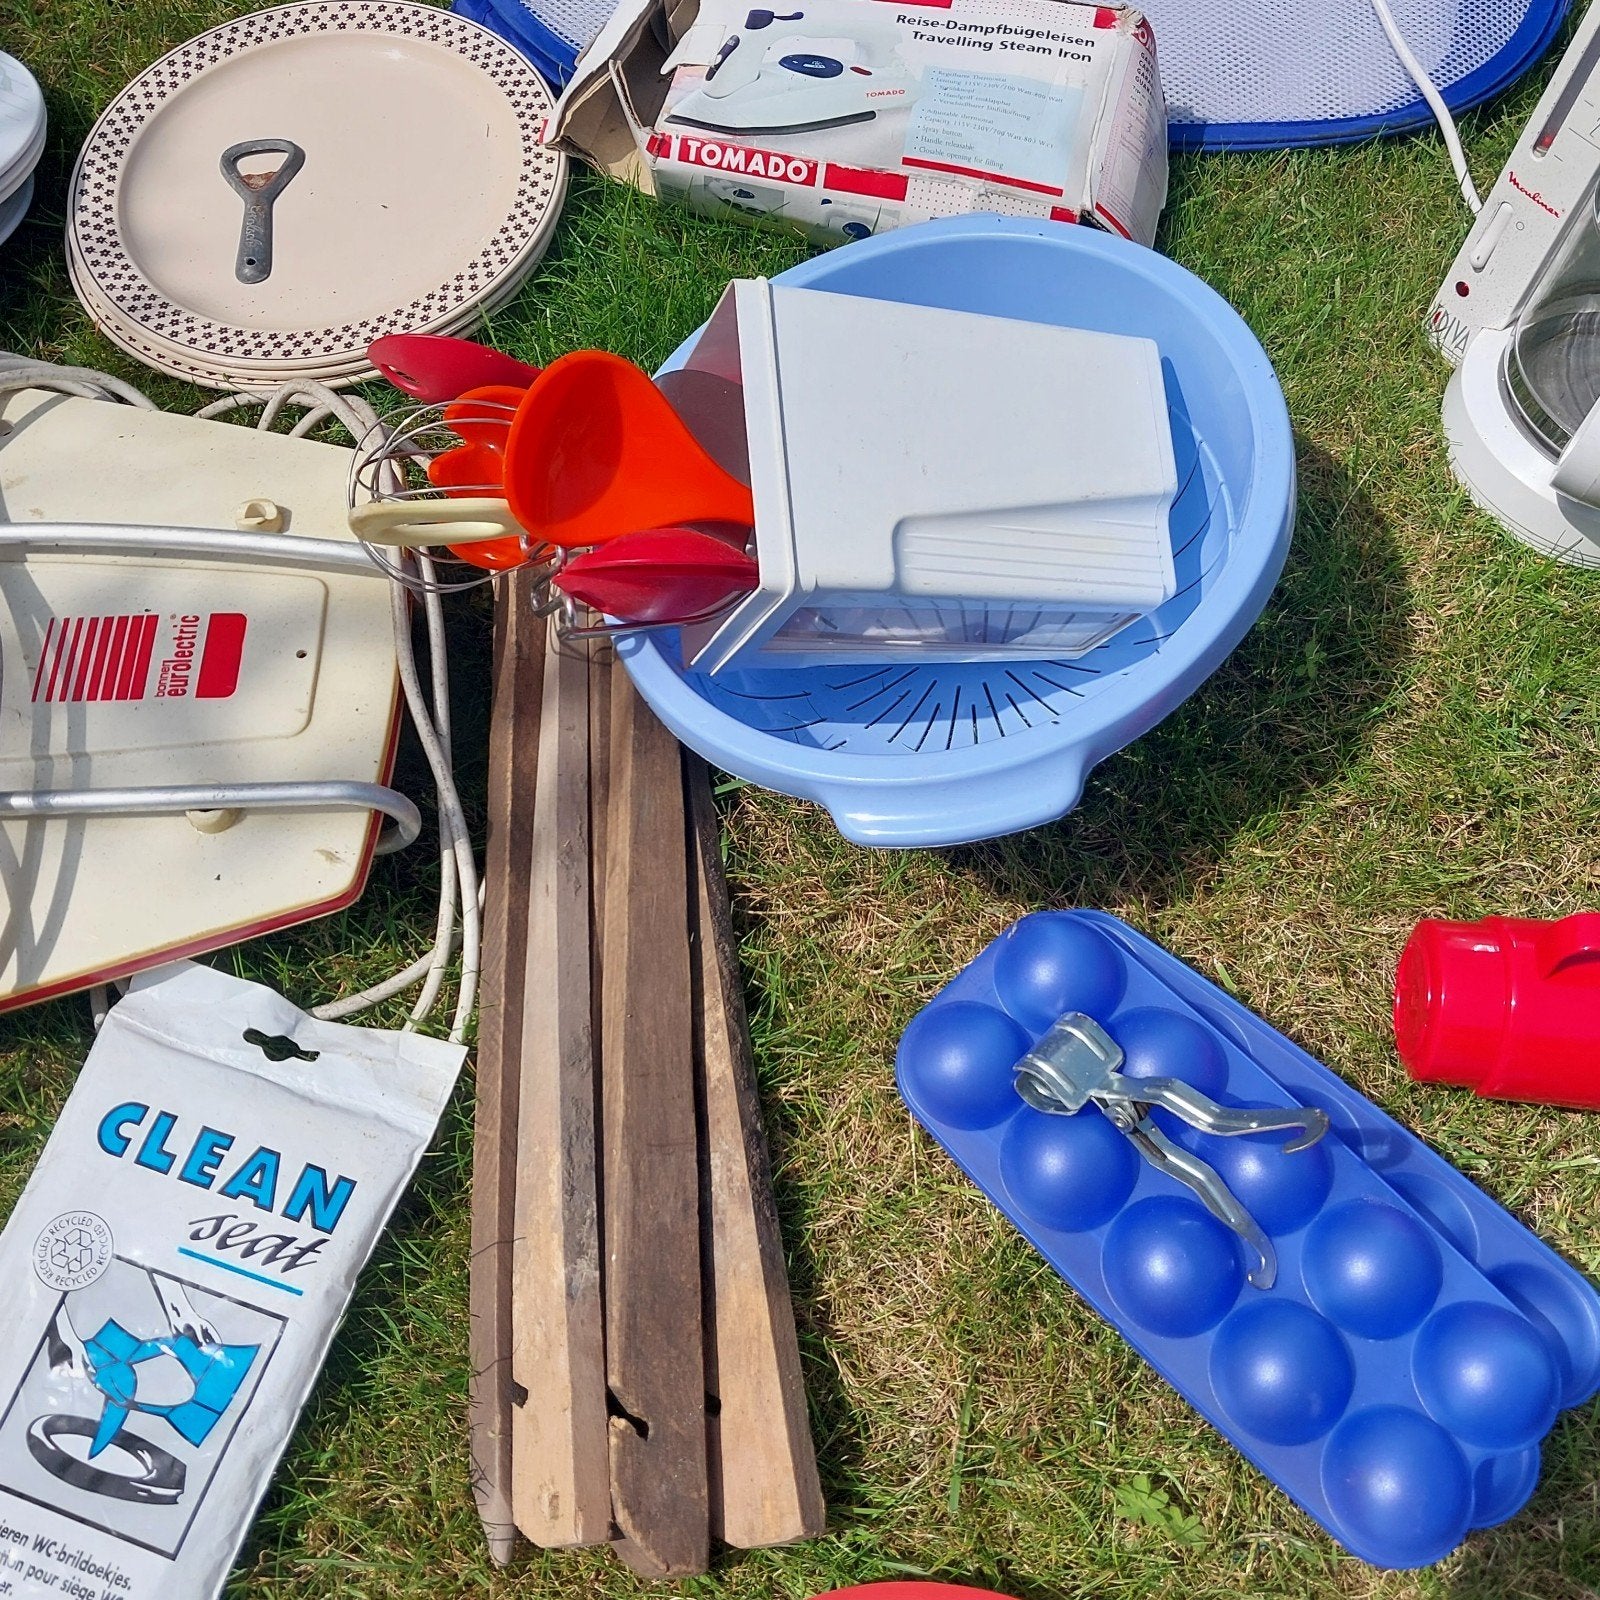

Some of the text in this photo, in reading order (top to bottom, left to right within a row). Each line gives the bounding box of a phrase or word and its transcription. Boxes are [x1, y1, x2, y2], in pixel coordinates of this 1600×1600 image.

[896, 14, 1096, 48] Reise-Dampfbügeleisen
[912, 30, 1092, 63] Travelling Steam Iron
[865, 88, 906, 98] TOMADO
[922, 125, 939, 134] Spray
[924, 115, 950, 125] Capacity
[918, 146, 1004, 170] Closable opening for filling
[921, 135, 975, 151] Handle releasable
[686, 139, 809, 184] TOMADO
[1508, 171, 1560, 219] Moulinex
[166, 613, 200, 698] eurolectric
[97, 1101, 358, 1236] CLEAN
[48, 1216, 93, 1236] RECYCLED
[37, 1236, 54, 1280] RECYCLED
[93, 1224, 109, 1266] RECYCLED
[188, 1213, 331, 1274] seat
[55, 1267, 98, 1287] RECYCLED
[0, 1519, 131, 1591] ieren WC-brildoekjes.
[23, 1564, 59, 1586] pour
